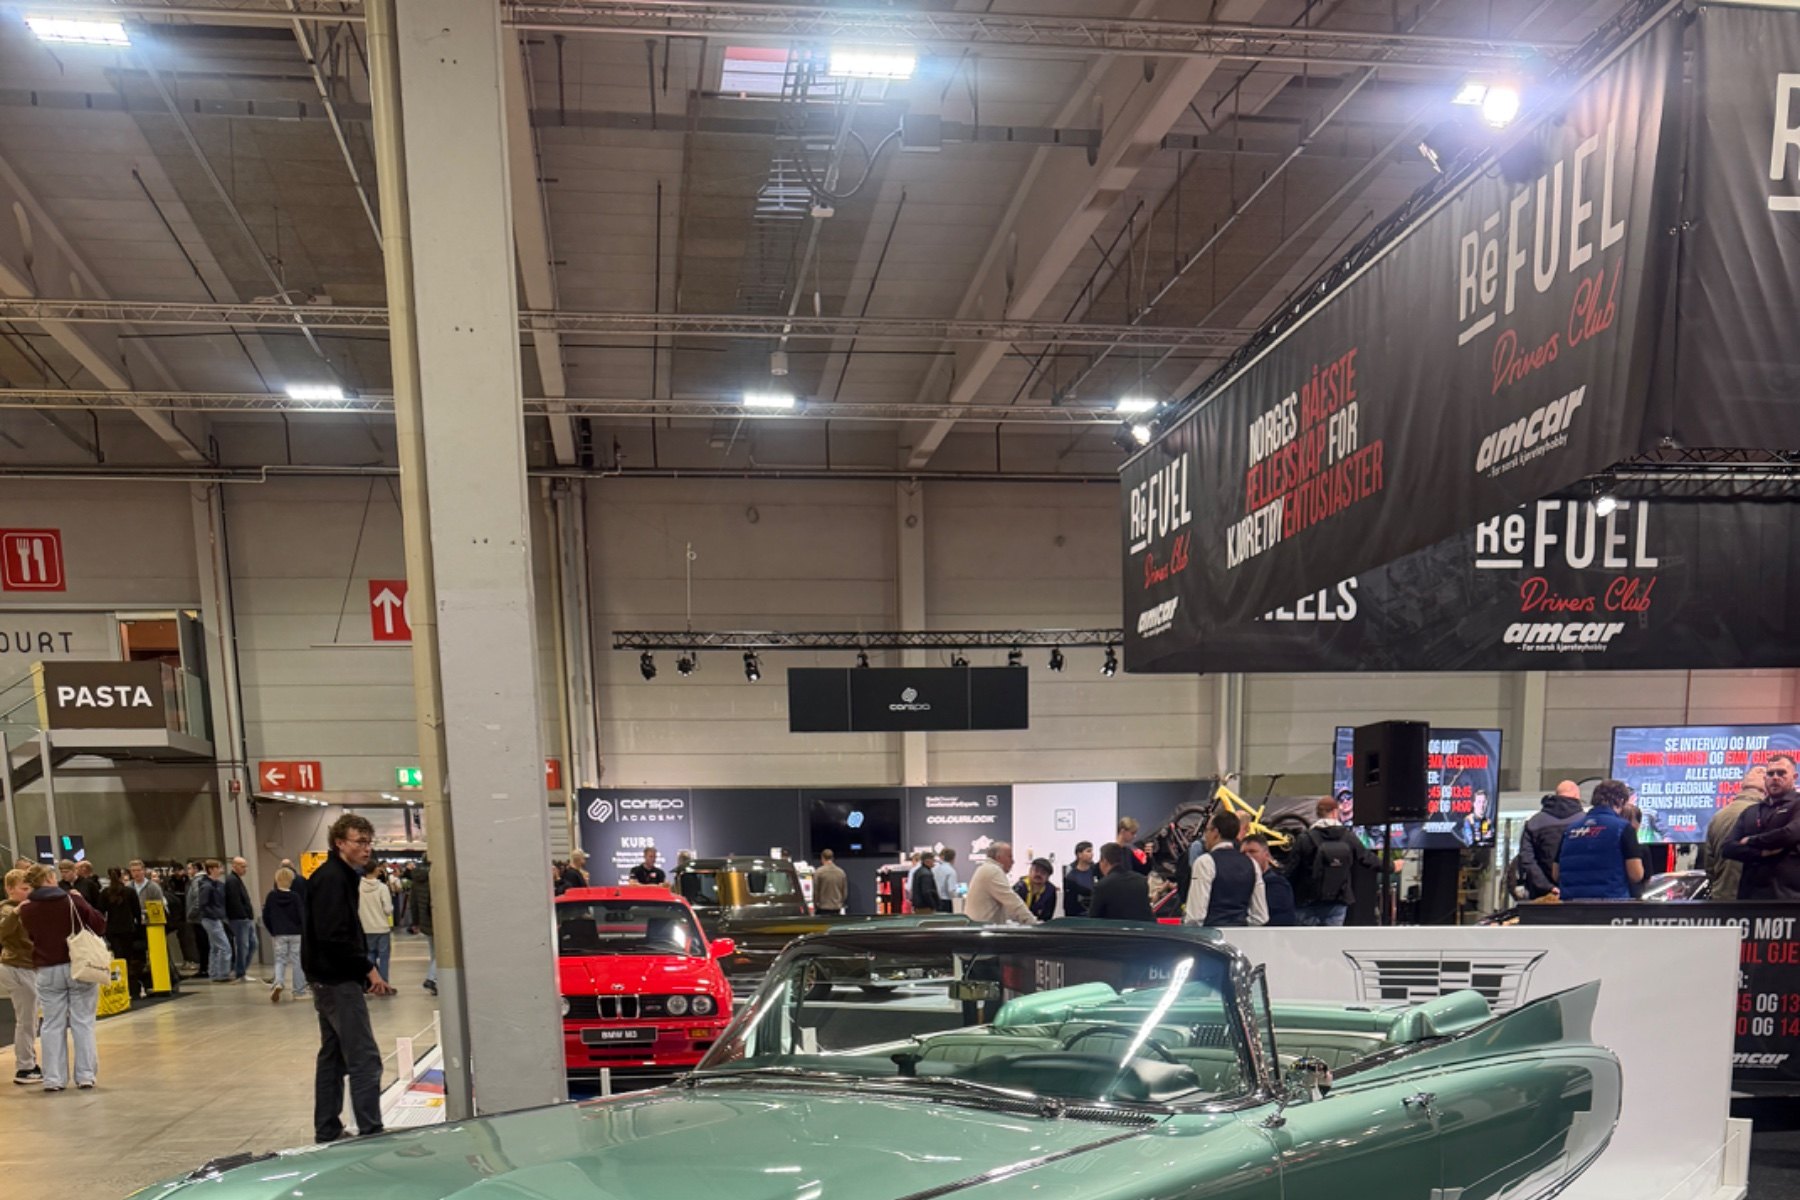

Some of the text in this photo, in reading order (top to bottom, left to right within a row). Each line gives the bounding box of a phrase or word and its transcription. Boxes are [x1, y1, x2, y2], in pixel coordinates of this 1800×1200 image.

[1492, 256, 1623, 395] Drivers Club
[1250, 347, 1358, 468] NORGES RÅESTE
[1476, 384, 1587, 473] amcar
[1246, 401, 1359, 514] FELLESSKAP FOR
[1520, 576, 1656, 612] Drivers Club
[1503, 622, 1625, 643] amcar
[57, 685, 153, 707] PASTA
[1665, 737, 1678, 751] SE
[1680, 737, 1728, 750] INTERVJU
[1730, 737, 1744, 750] OG
[1709, 751, 1723, 765] OG
[1685, 768, 1708, 781] ALLE
[1642, 782, 1664, 795] EMIL
[1640, 796, 1673, 809] DENNIS
[621, 837, 654, 848] KURS
[1754, 917, 1796, 939] MØT
[1756, 993, 1778, 1012] OG
[1752, 1017, 1774, 1036] OG
